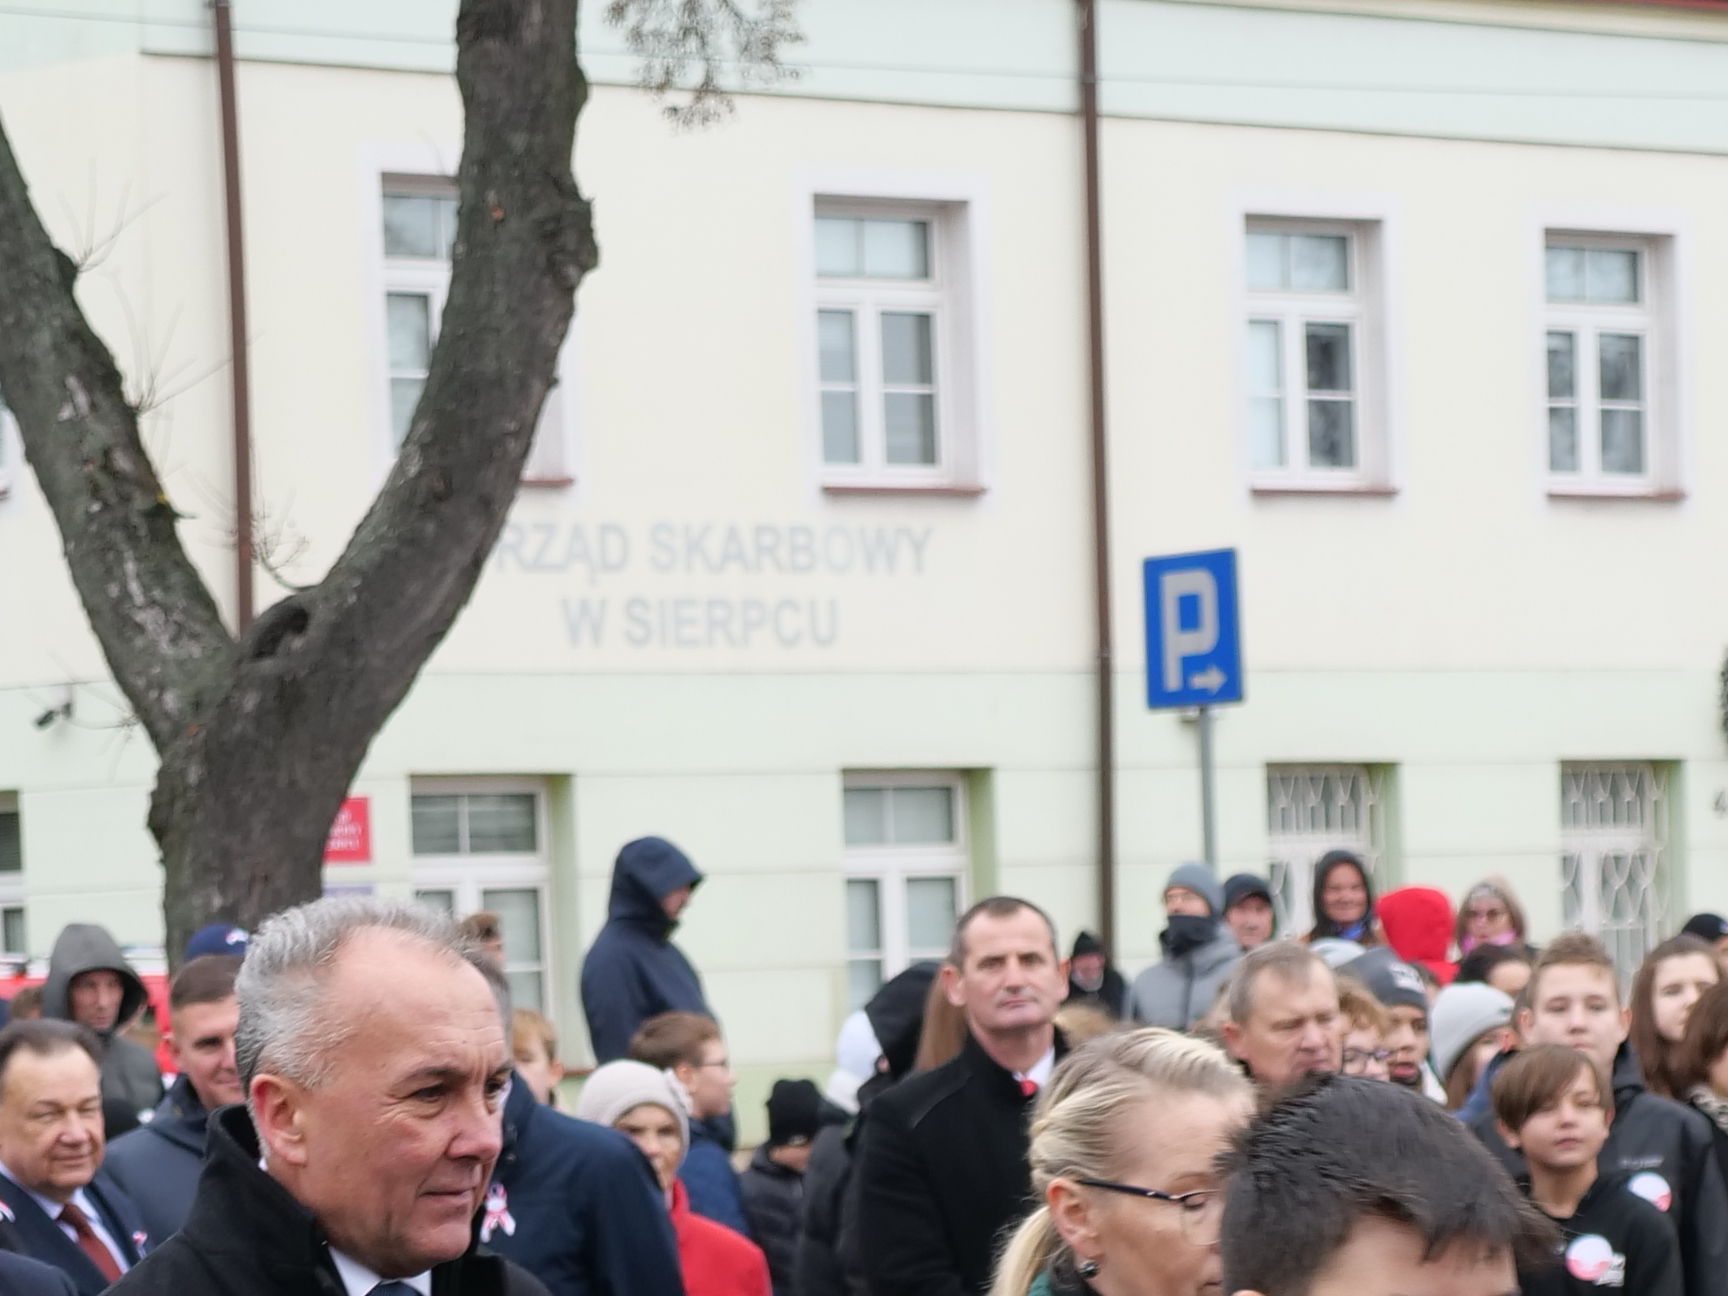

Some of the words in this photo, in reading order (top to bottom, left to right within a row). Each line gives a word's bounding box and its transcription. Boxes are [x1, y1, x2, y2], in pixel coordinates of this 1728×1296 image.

[495, 522, 630, 587] RZĄD
[650, 522, 934, 577] SKARBOWY
[561, 598, 606, 648] W
[624, 597, 840, 648] SIERPCU
[1160, 568, 1220, 692] P
